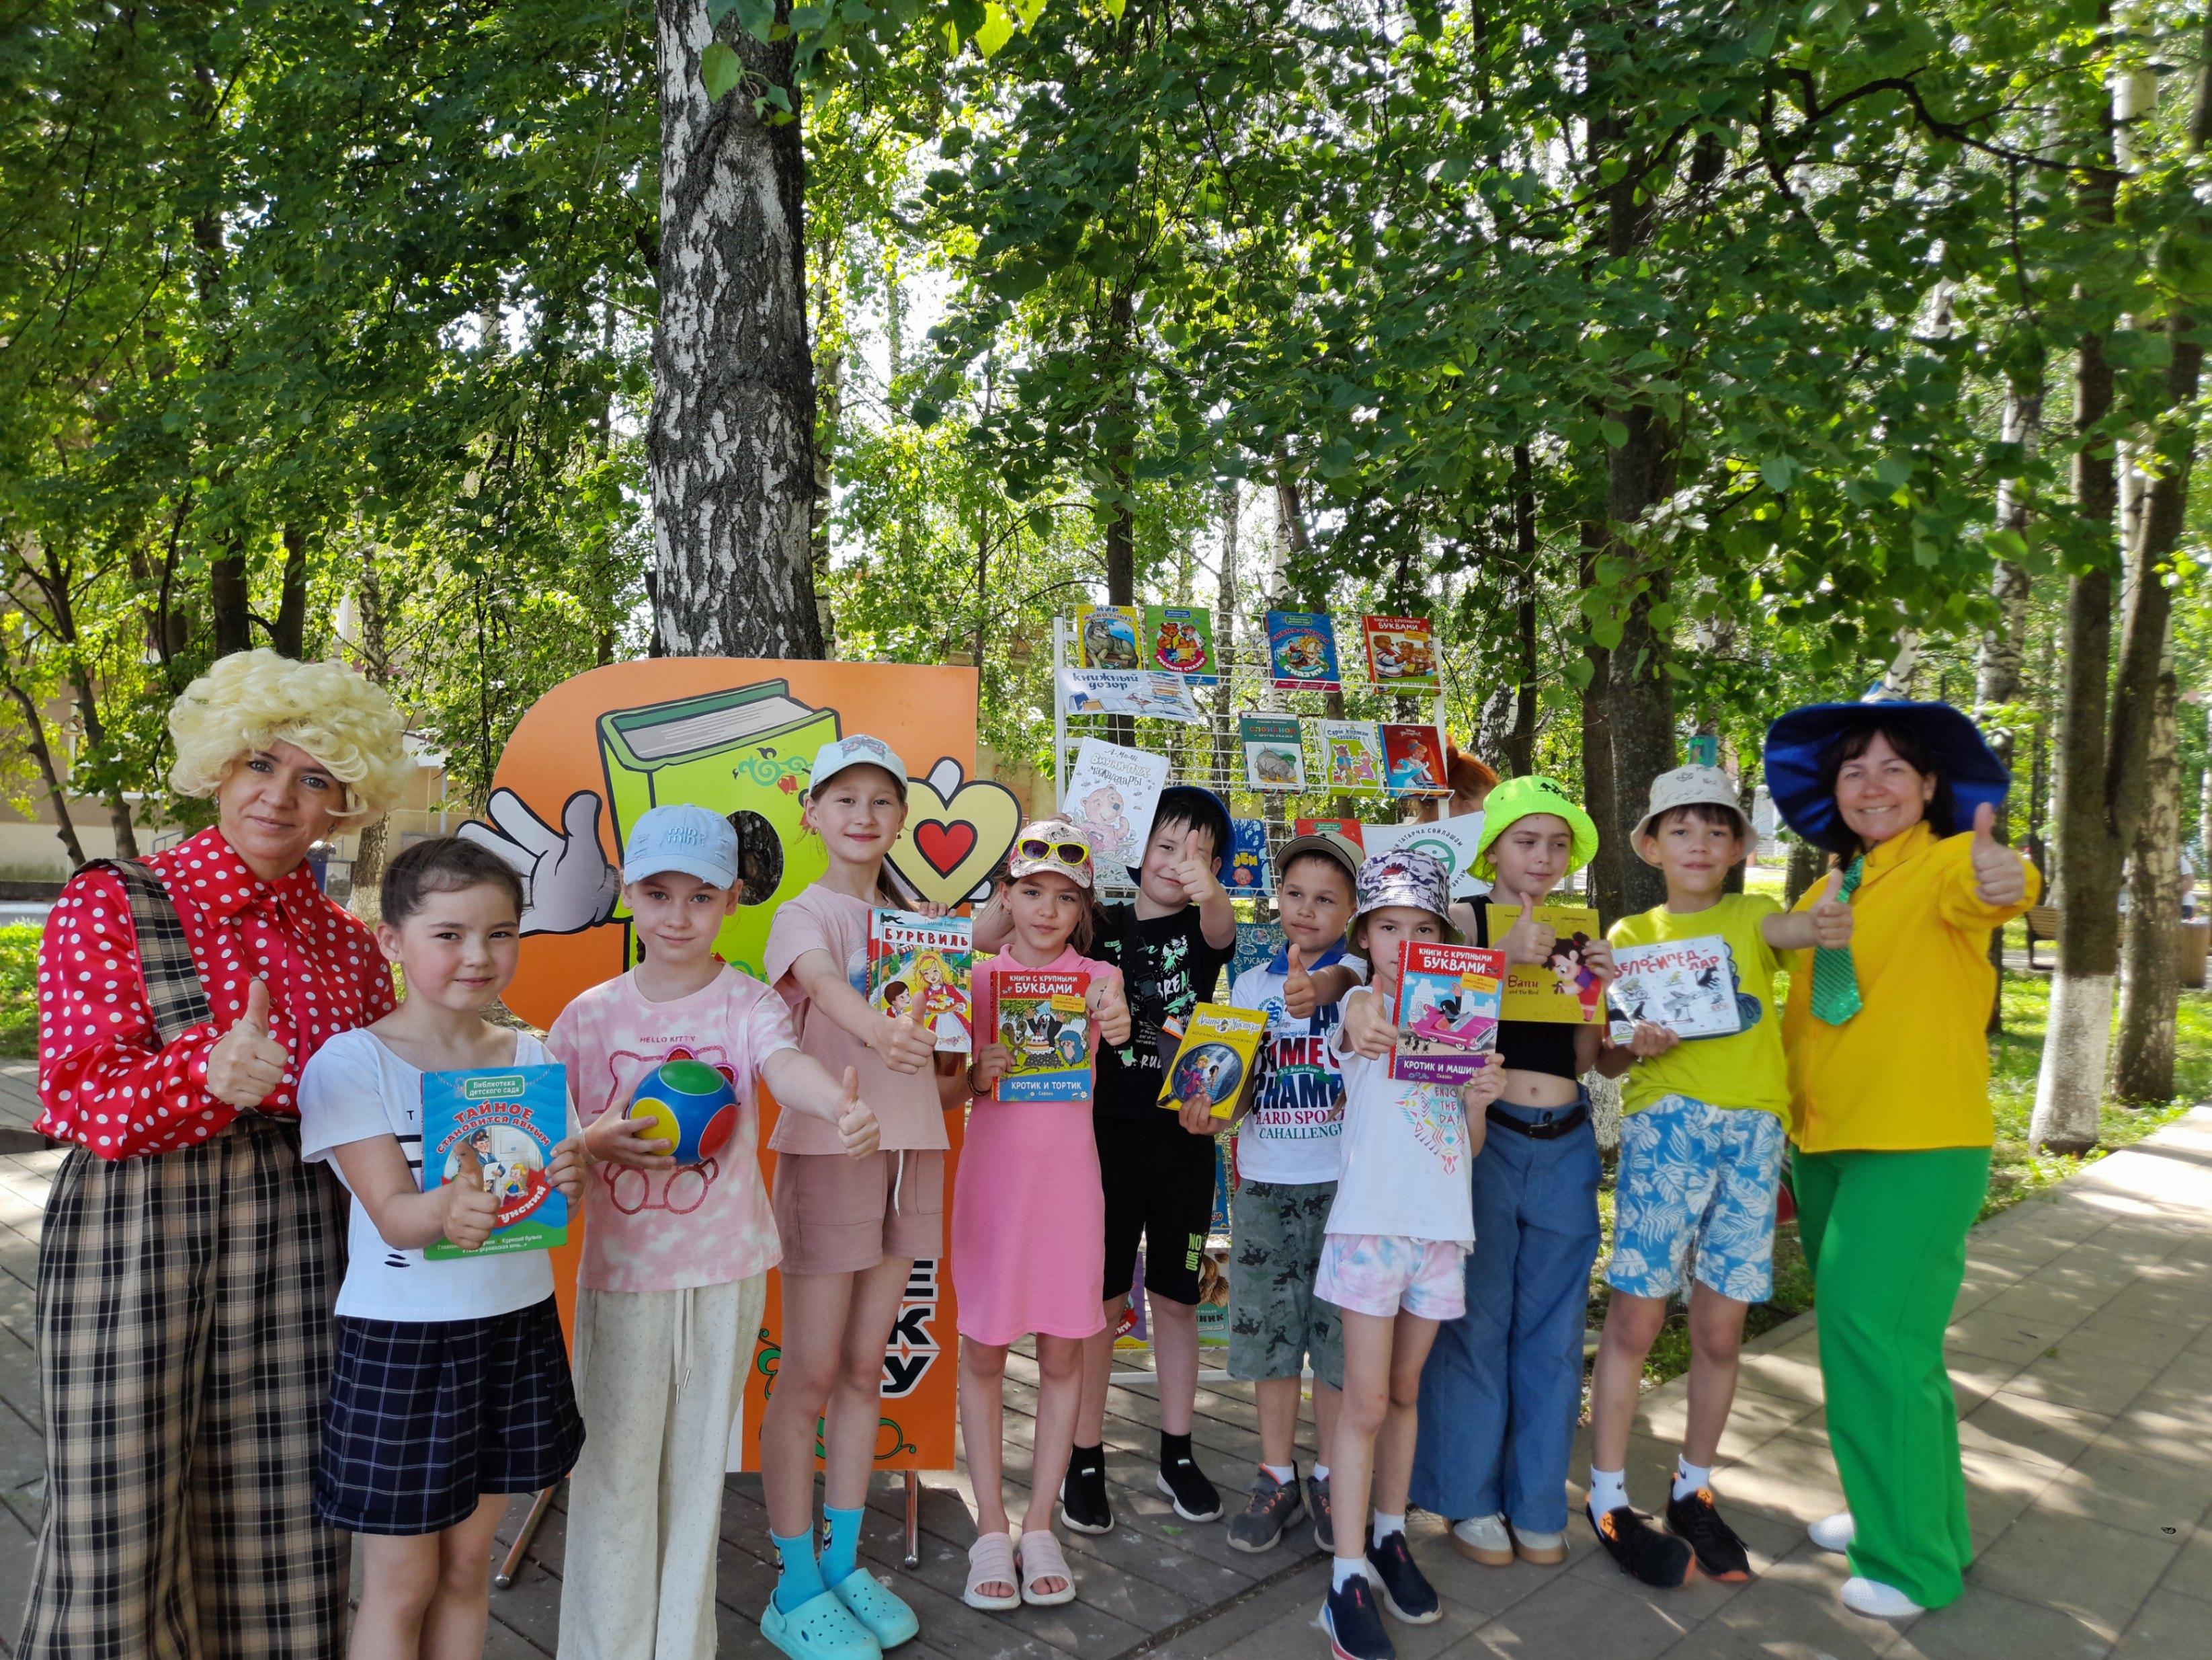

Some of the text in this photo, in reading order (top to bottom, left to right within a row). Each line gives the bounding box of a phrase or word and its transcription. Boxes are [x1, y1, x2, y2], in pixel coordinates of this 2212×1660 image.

[1083, 612, 1133, 622] ЖИВОТНЫХ
[1378, 622, 1418, 631] БУКВАМИ
[1088, 681, 1129, 690] дозор
[1399, 829, 1425, 844] ТАТАРЧА
[885, 928, 969, 947] БУРКВИЛЬ
[1418, 947, 1442, 957] КНИГИ
[1450, 951, 1493, 961] КРУПНЫМИ
[1243, 956, 1274, 965] РУСАЛО
[1423, 957, 1485, 974] БУКВАМИ
[1688, 955, 1720, 970] ЛАР
[1508, 974, 1539, 989] Banu
[1015, 982, 1073, 994] БУКВАМИ
[1403, 1060, 1436, 1072] КРОТИК
[473, 1080, 516, 1089] Библиотека
[1012, 1081, 1081, 1090] КРОТИК И ТОРТИК
[468, 1086, 520, 1097] детского сада
[1434, 1086, 1459, 1097] ENJO
[453, 1099, 534, 1124] ТАЙНОЕ
[1440, 1101, 1457, 1111] THE
[1256, 1111, 1292, 1125] HARD
[437, 1115, 550, 1154] СТАНОВИТСЯ ЯВНЫМ
[498, 1185, 547, 1223] УНСКИЙ
